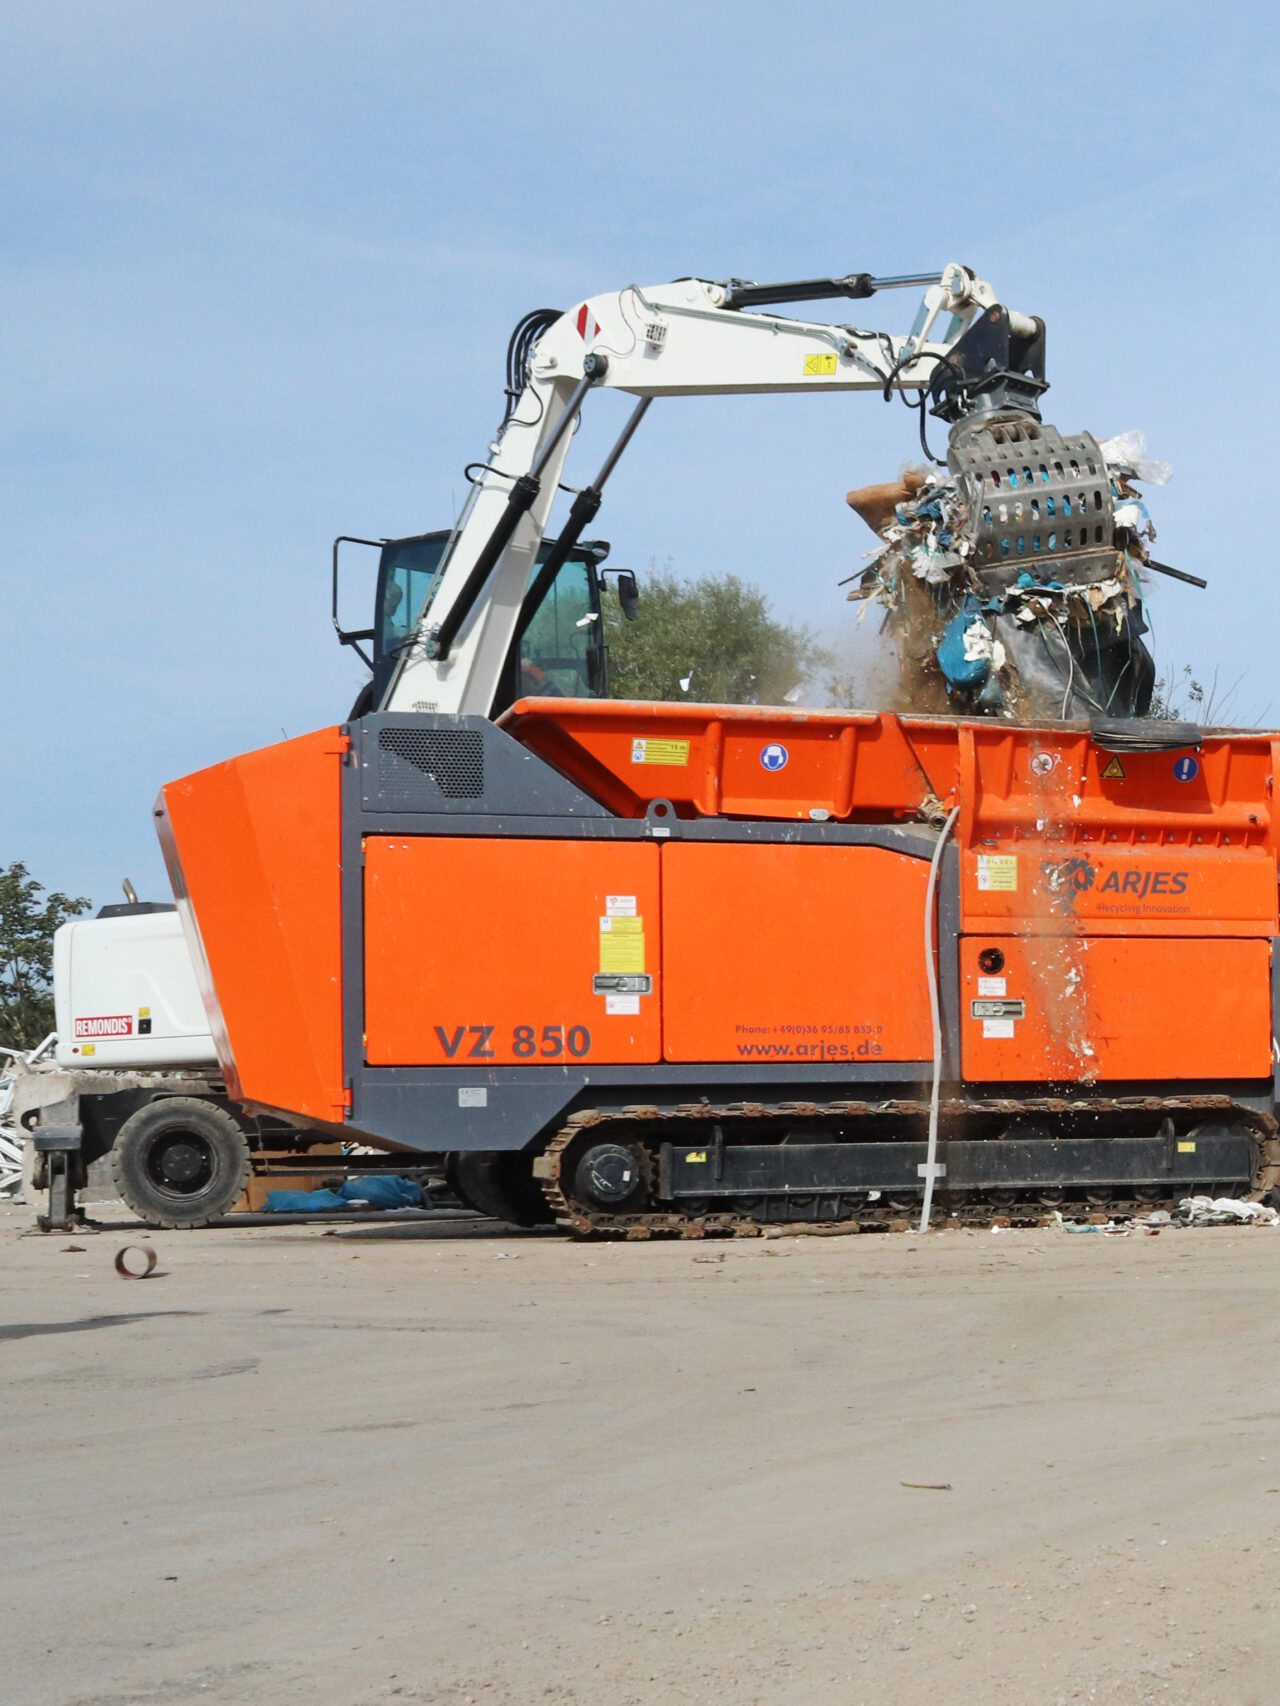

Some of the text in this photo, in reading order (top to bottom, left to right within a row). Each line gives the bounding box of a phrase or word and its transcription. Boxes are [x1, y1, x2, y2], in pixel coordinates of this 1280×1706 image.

[1100, 871, 1189, 899] ARJES
[1098, 903, 1189, 914] Recycling Innovation
[735, 1025, 771, 1033] Phone:
[434, 1025, 591, 1058] VZ 850
[737, 1040, 884, 1060] www.arjes.de
